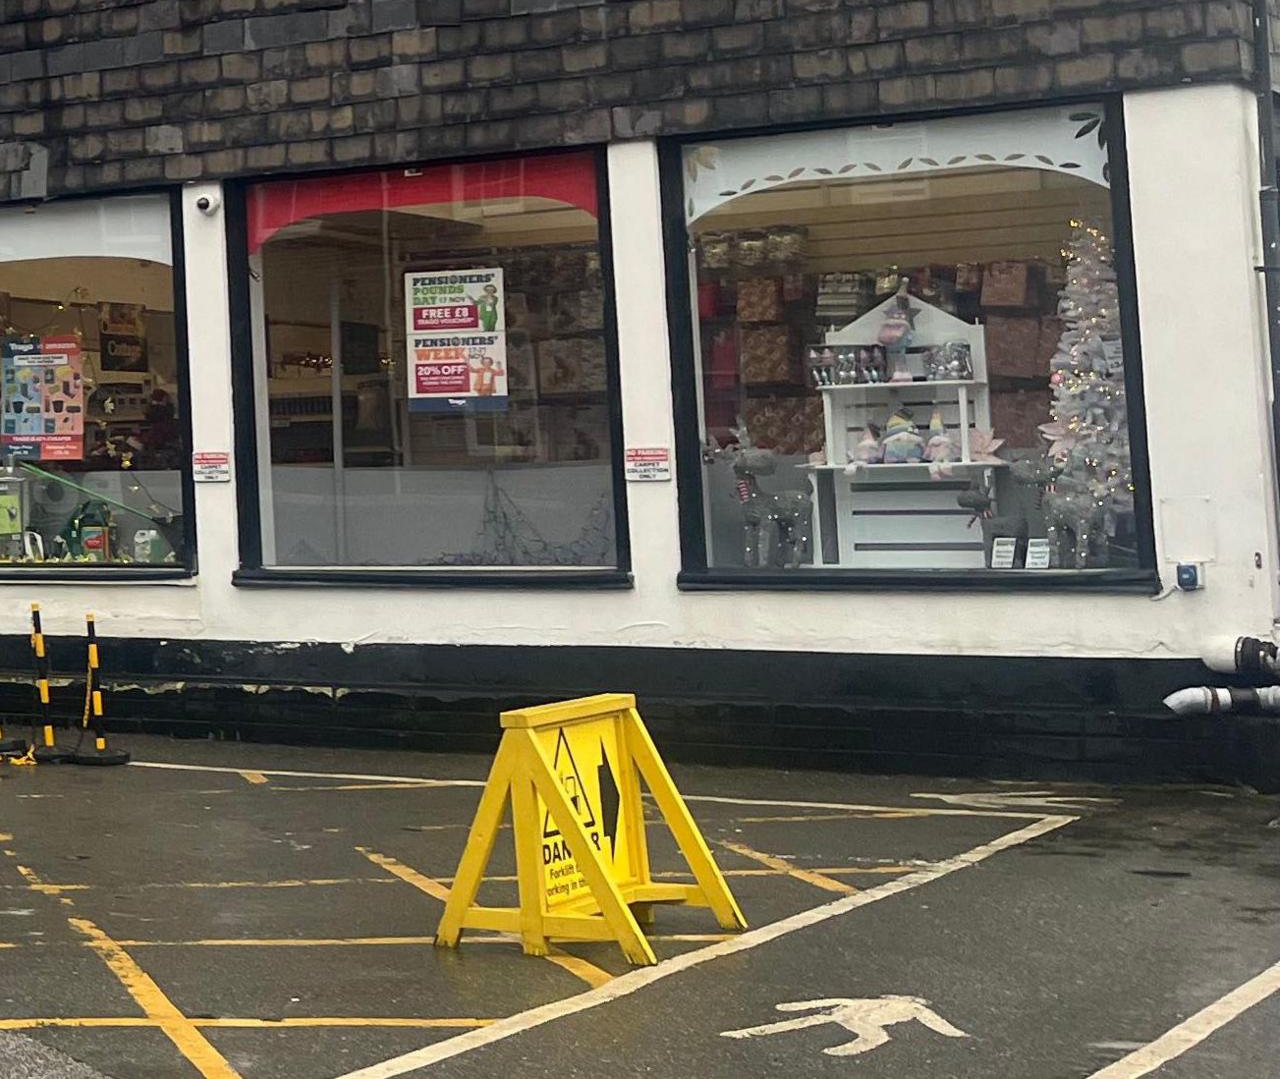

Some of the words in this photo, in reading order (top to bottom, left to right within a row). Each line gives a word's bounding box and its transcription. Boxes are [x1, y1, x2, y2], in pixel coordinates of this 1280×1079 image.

[412, 285, 464, 296] POUNDS
[413, 297, 437, 306] DAY
[422, 309, 451, 319] FREE
[454, 307, 469, 318] £8
[9, 342, 34, 352] Trago
[416, 348, 467, 360] WEEK
[417, 365, 440, 376] 20%
[543, 830, 601, 865] DANR
[550, 863, 575, 880] Forklift
[546, 884, 570, 897] orking
